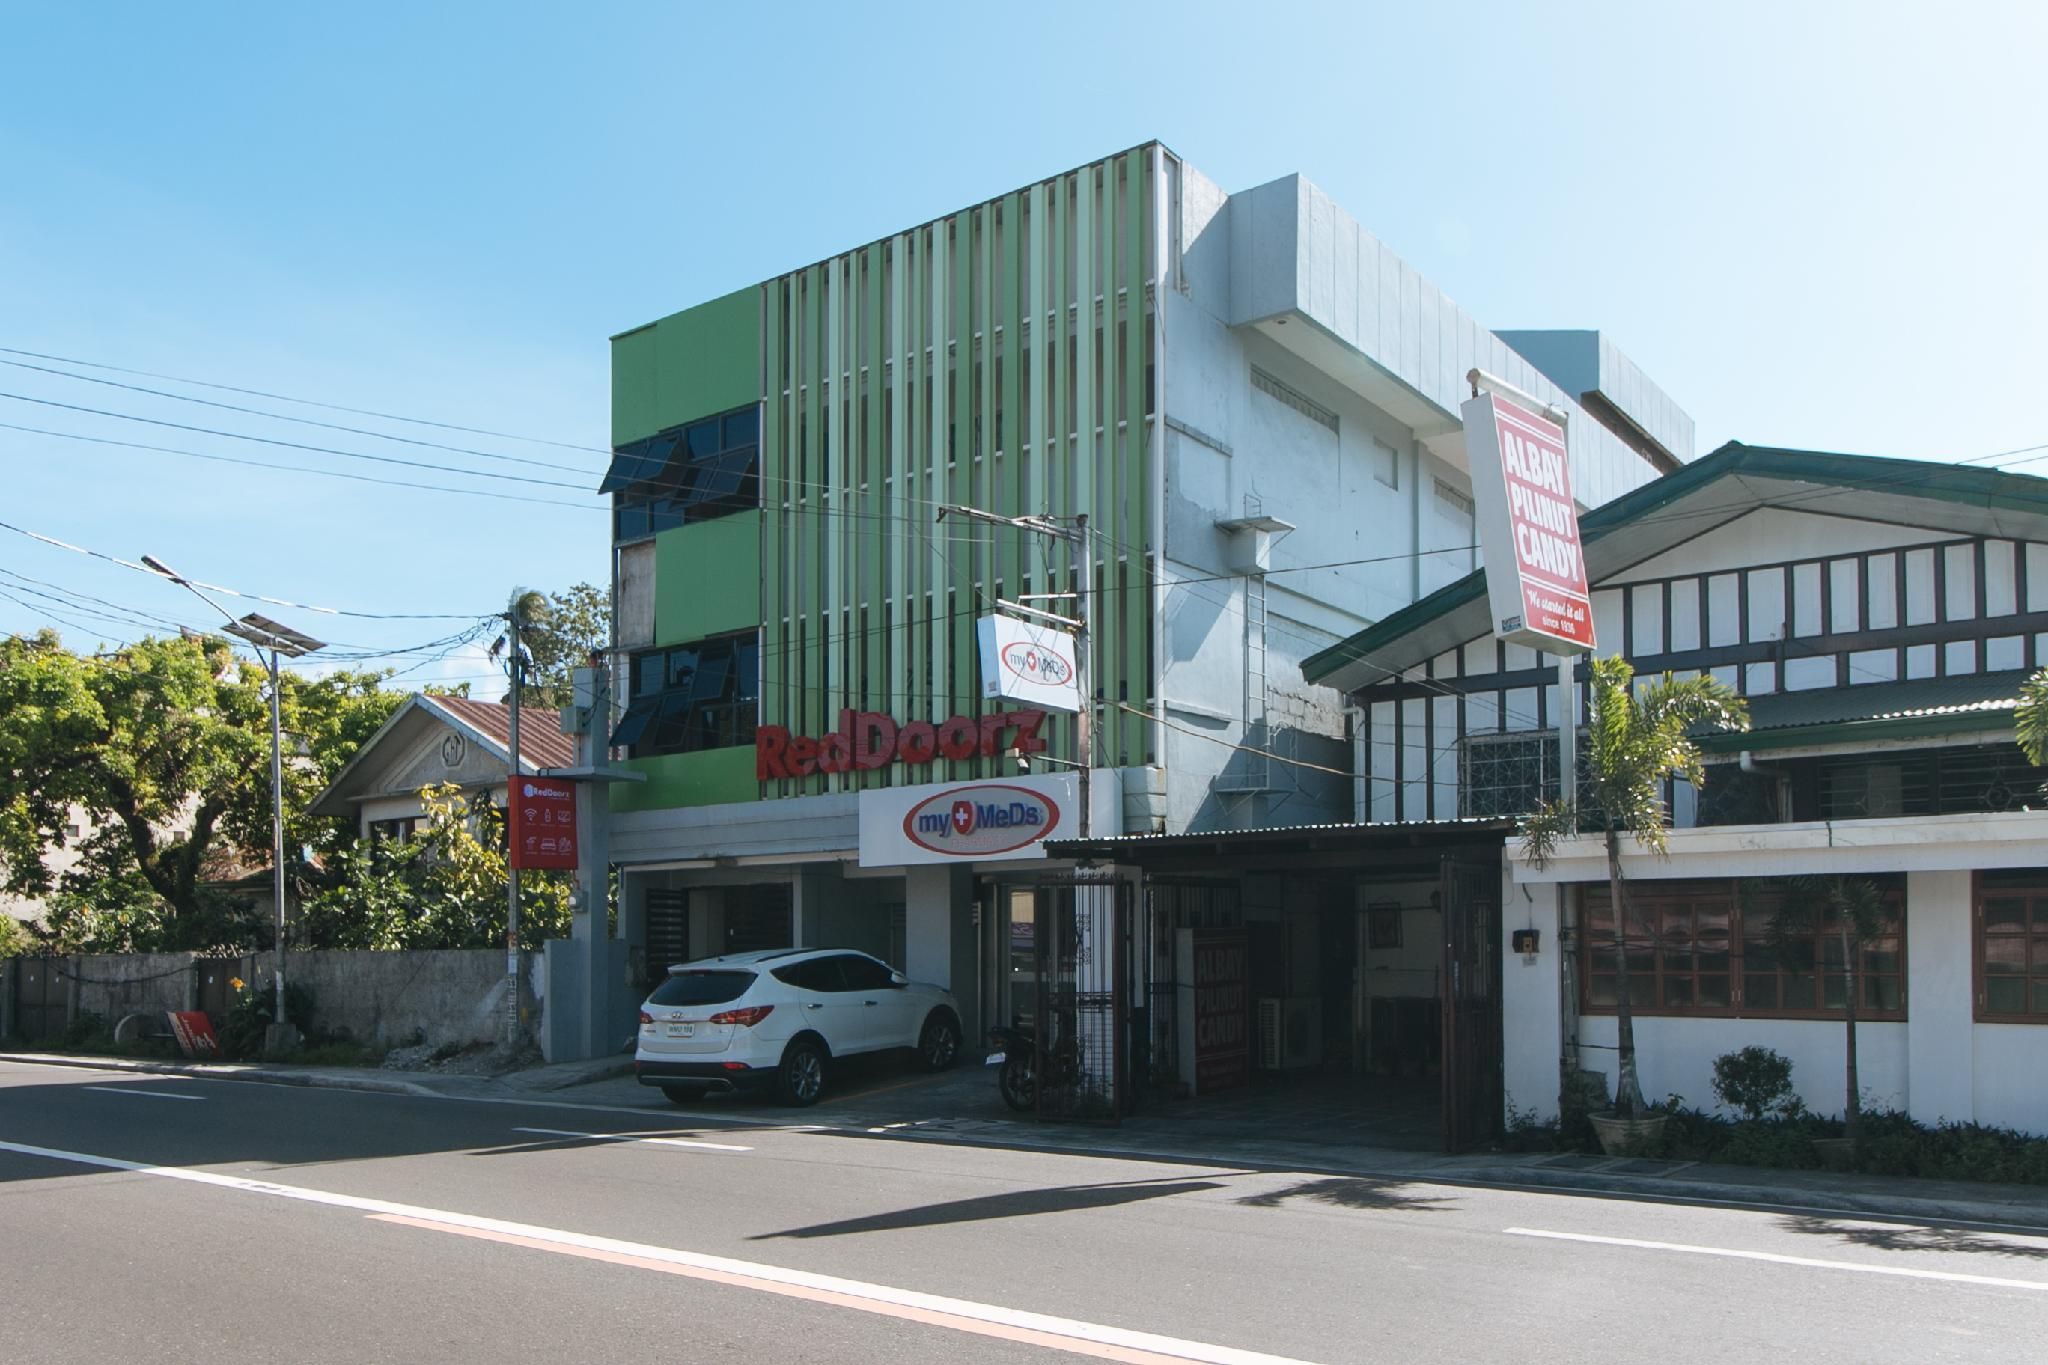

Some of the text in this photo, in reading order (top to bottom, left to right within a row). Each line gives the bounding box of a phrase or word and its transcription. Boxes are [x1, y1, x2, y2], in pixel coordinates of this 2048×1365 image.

[1504, 431, 1565, 497] ALBAY
[1510, 482, 1572, 537] PILINUT
[1517, 522, 1579, 582] CANDY
[1542, 616, 1559, 629] since
[1567, 604, 1573, 618] it
[1574, 607, 1584, 622] all
[1010, 653, 1026, 669] my
[756, 708, 1047, 781] RedDoorz
[918, 802, 1041, 838] my MeDs
[1199, 946, 1243, 982] ALBAY
[1199, 1014, 1243, 1049] CANDY
